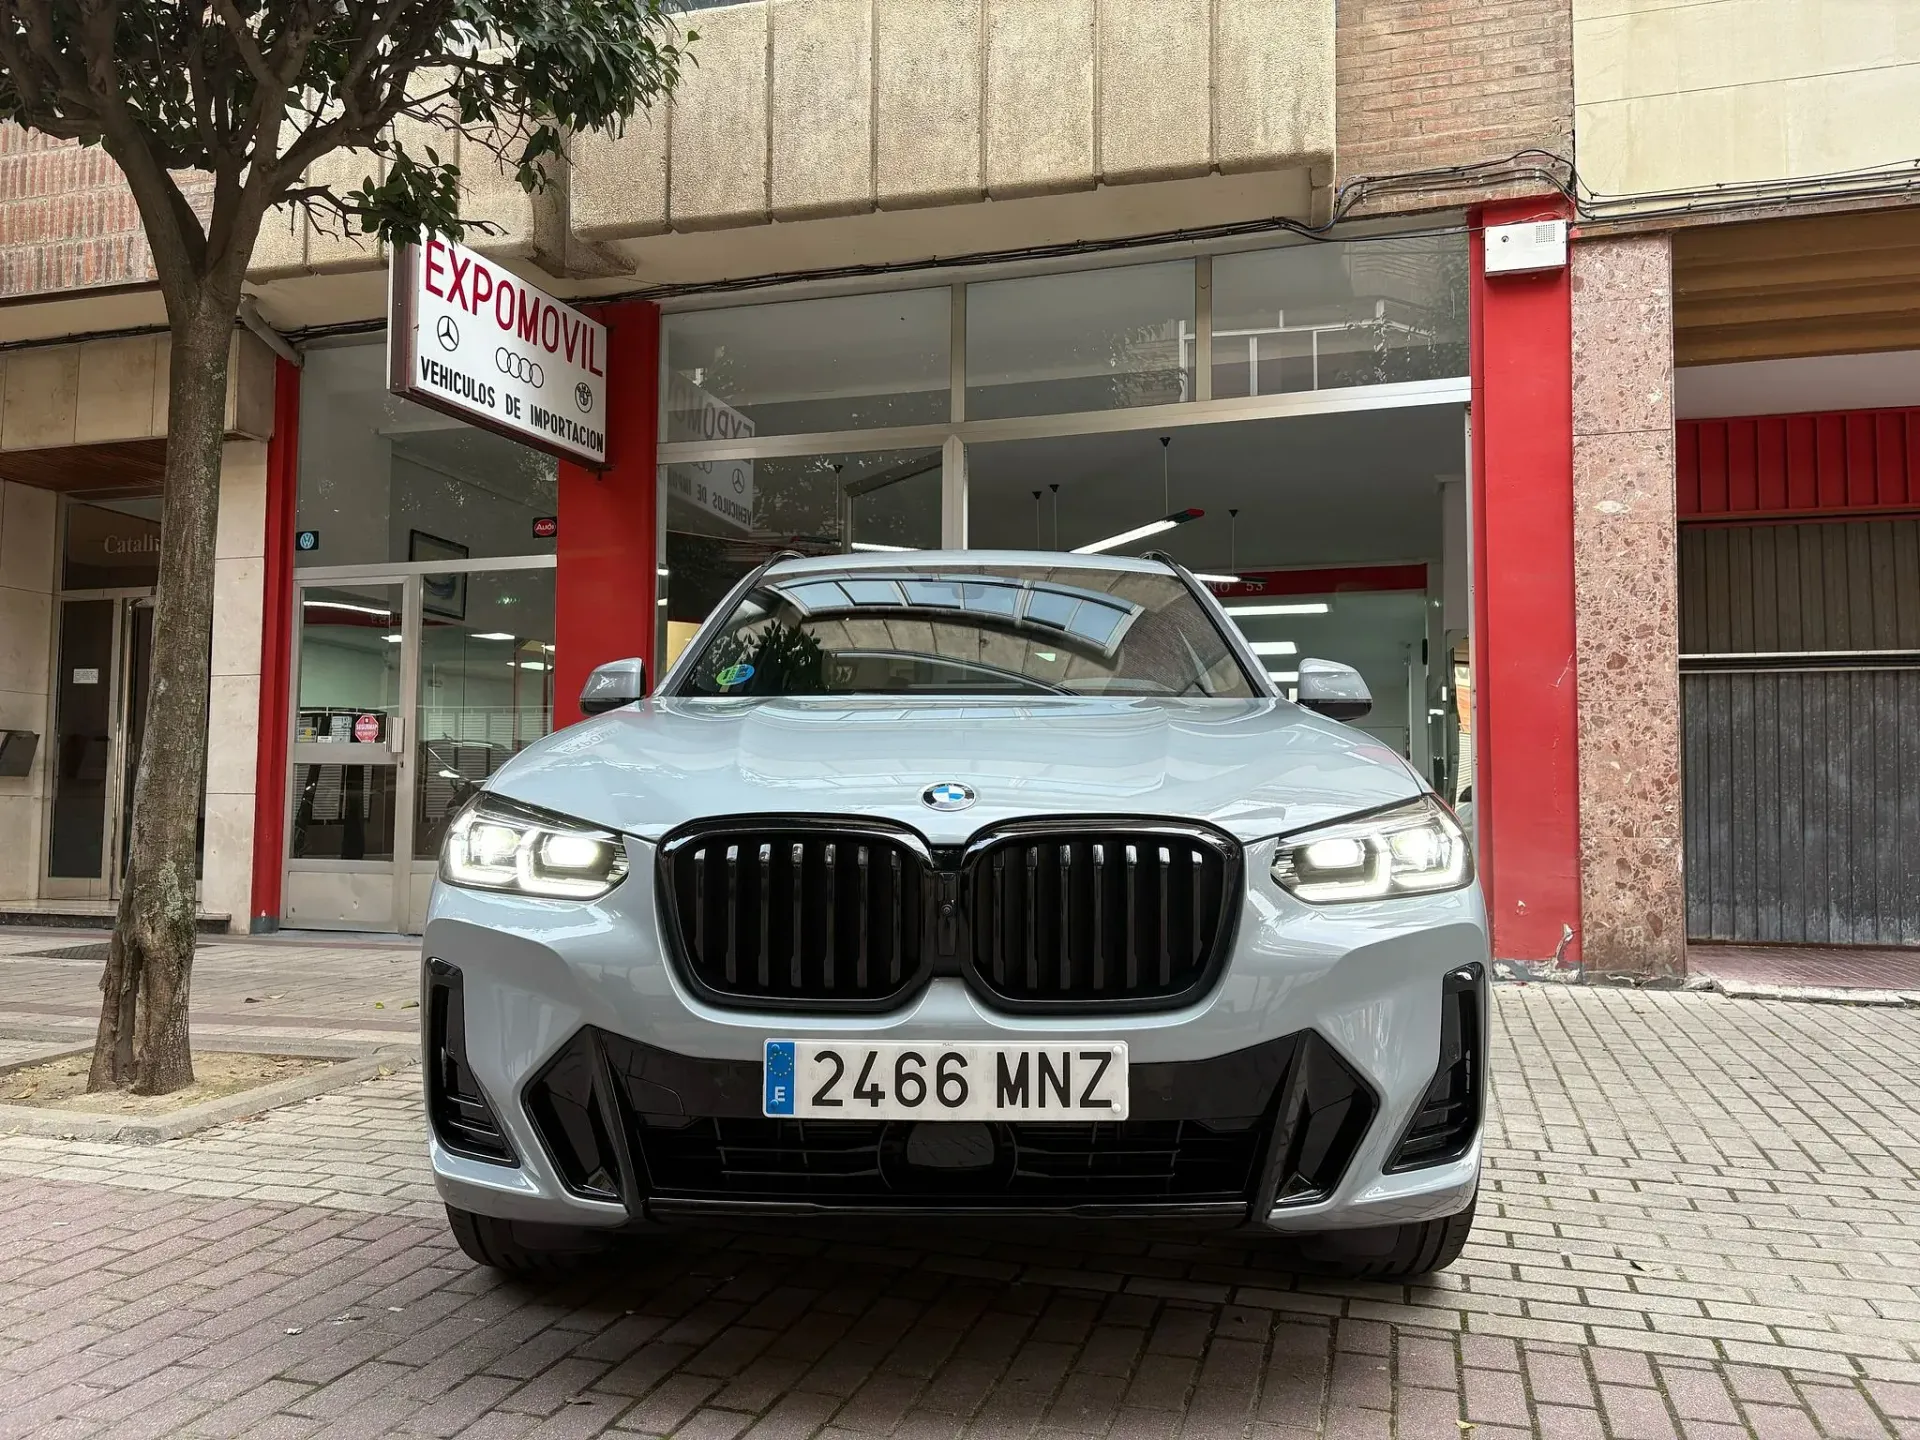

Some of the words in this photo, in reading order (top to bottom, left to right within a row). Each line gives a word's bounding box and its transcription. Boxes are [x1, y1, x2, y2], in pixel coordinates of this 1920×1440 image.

[425, 240, 603, 377] EXPOMOVIL
[421, 356, 495, 408] VEHICULOS
[505, 393, 521, 420] DE
[530, 404, 604, 454] IMPORTACION
[774, 1086, 786, 1102] E
[811, 1051, 969, 1108] 2466
[996, 1051, 1113, 1108] MNZ
